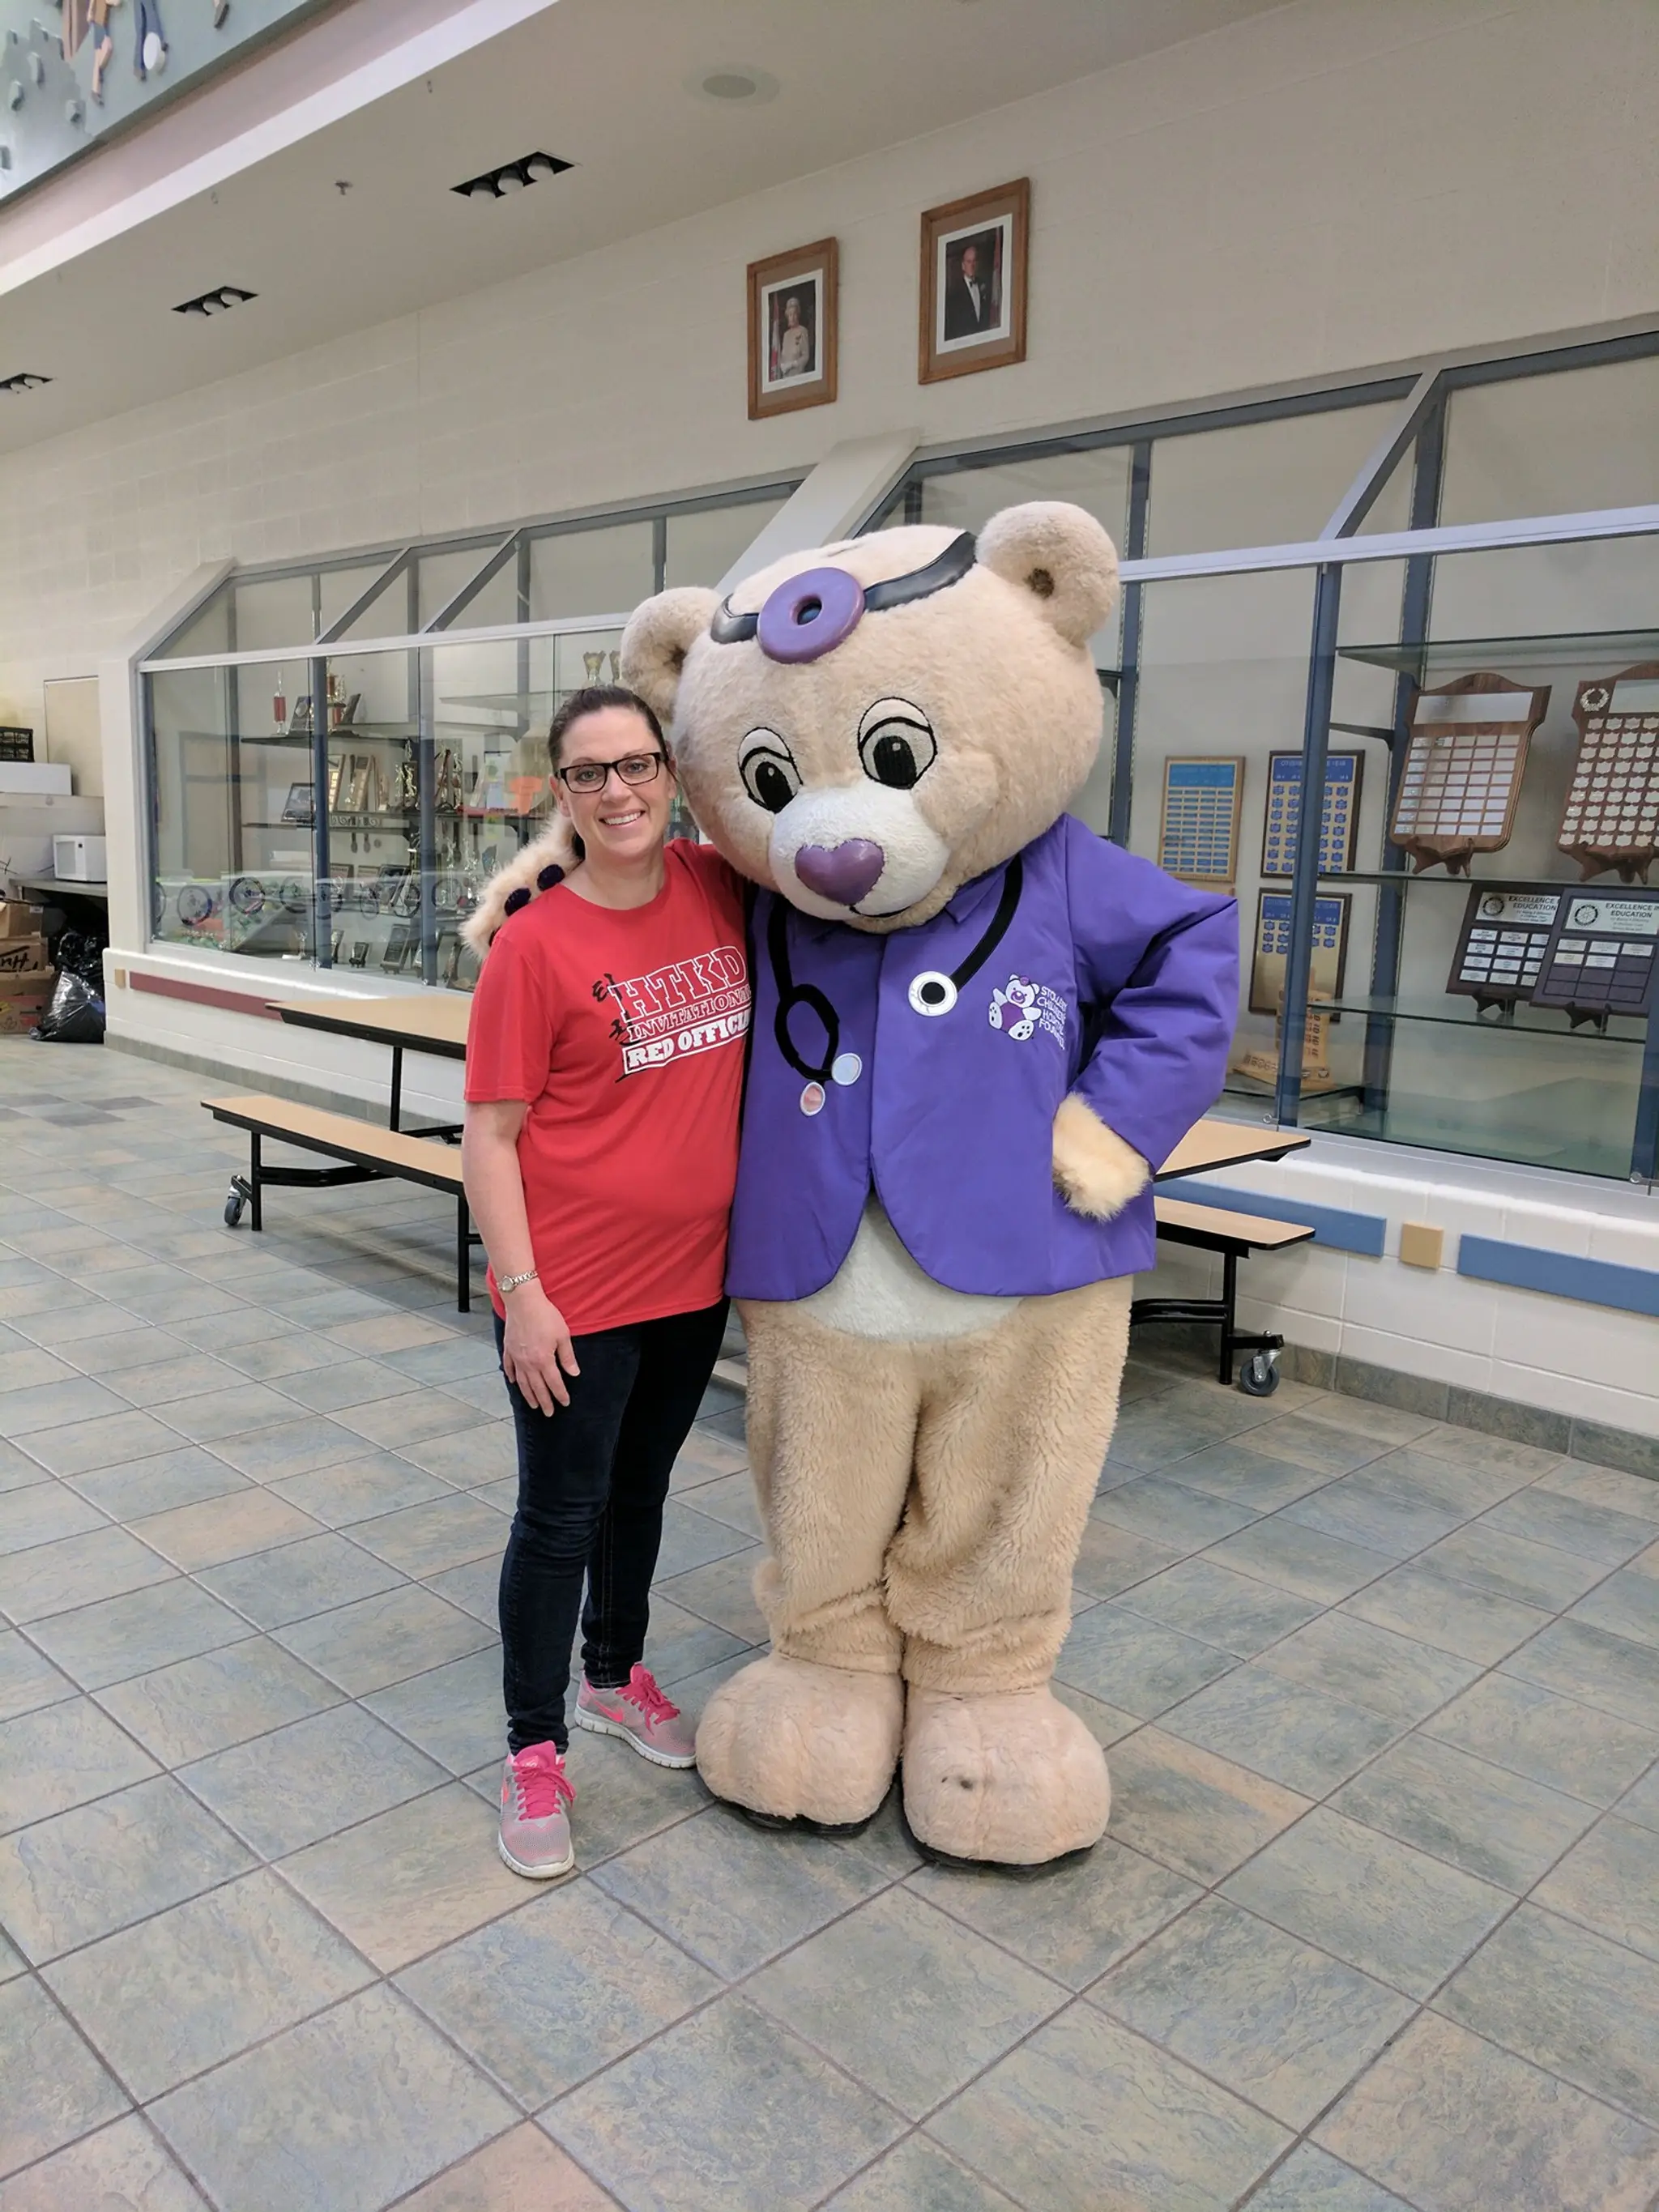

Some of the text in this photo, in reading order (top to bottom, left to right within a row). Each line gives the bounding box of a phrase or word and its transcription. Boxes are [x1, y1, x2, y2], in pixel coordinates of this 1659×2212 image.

[1508, 895, 1555, 904] EXCELLENCE
[1512, 902, 1557, 910] EDUCATION
[1606, 902, 1653, 911] EXCELLENCE
[1610, 910, 1653, 918] EDUCATION
[607, 945, 746, 1024] HTKD
[627, 1007, 752, 1068] RED OFFICIA
